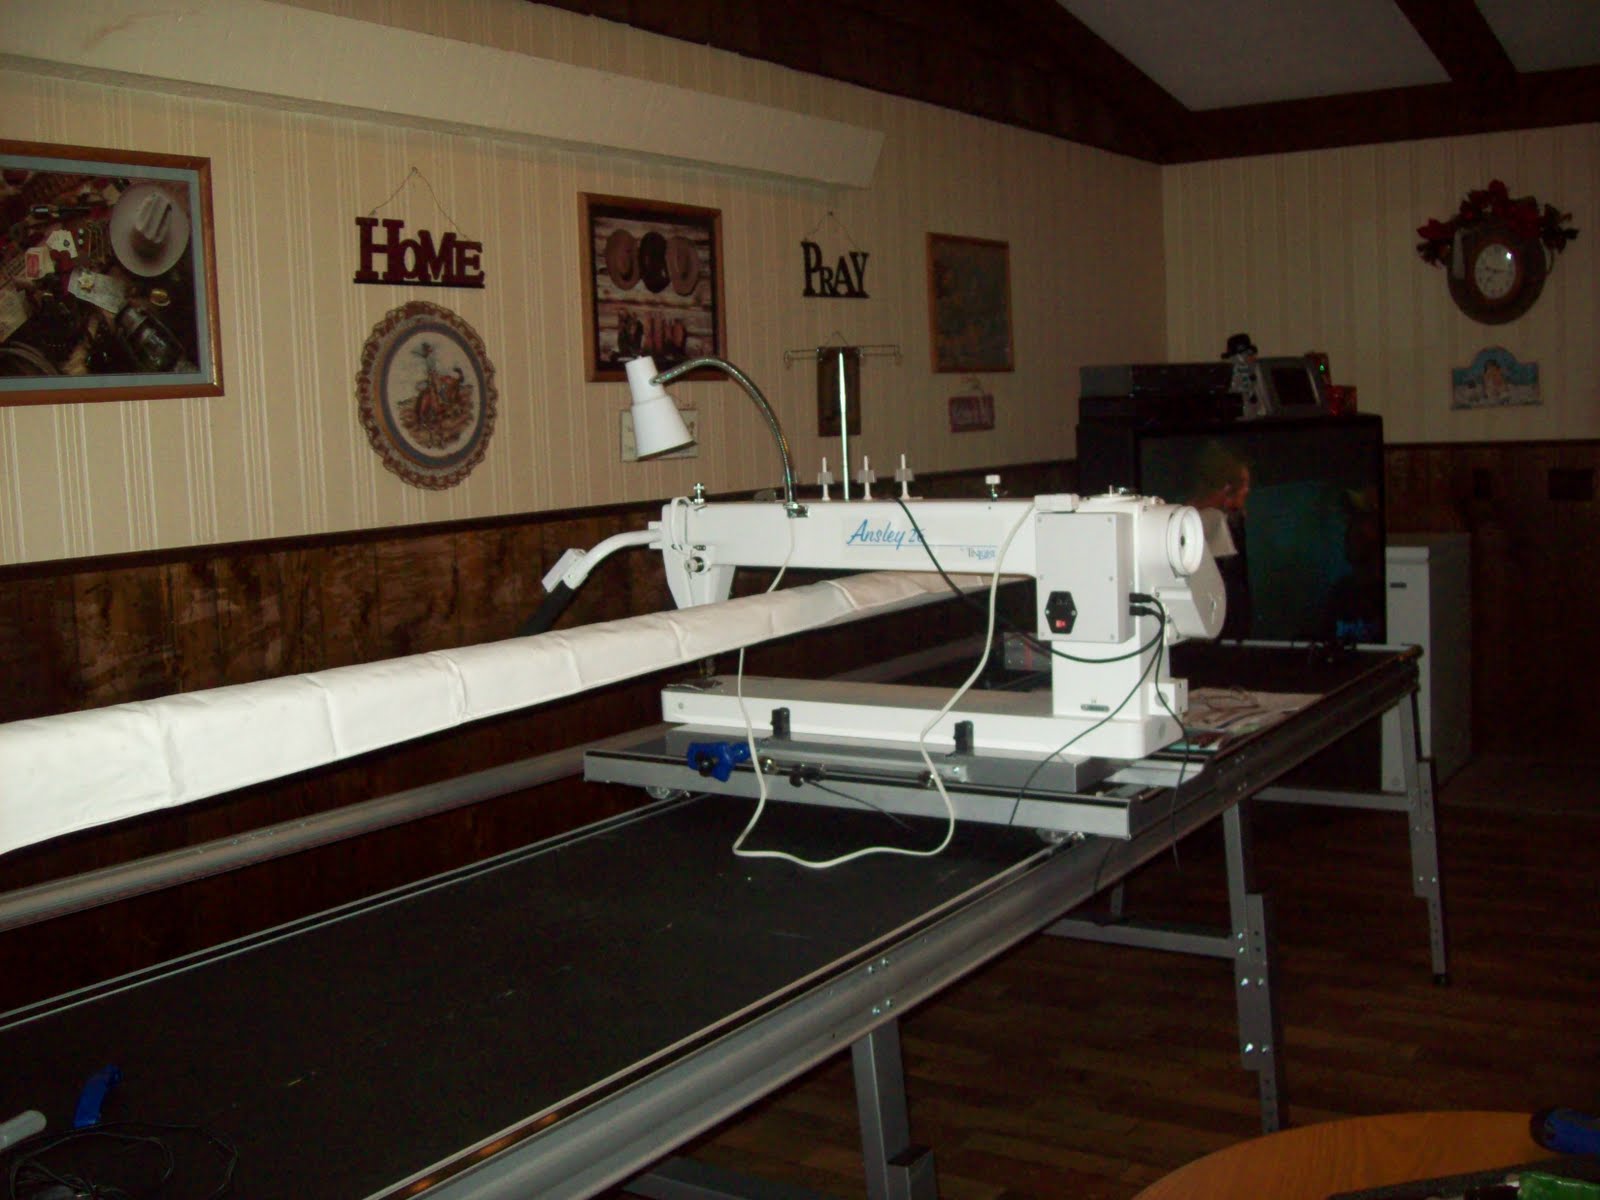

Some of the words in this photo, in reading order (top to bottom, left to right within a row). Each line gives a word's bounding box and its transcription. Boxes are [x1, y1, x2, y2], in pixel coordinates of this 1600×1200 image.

[354, 216, 484, 287] HOME
[800, 240, 870, 299] PRAY
[846, 518, 906, 550] Ansley
